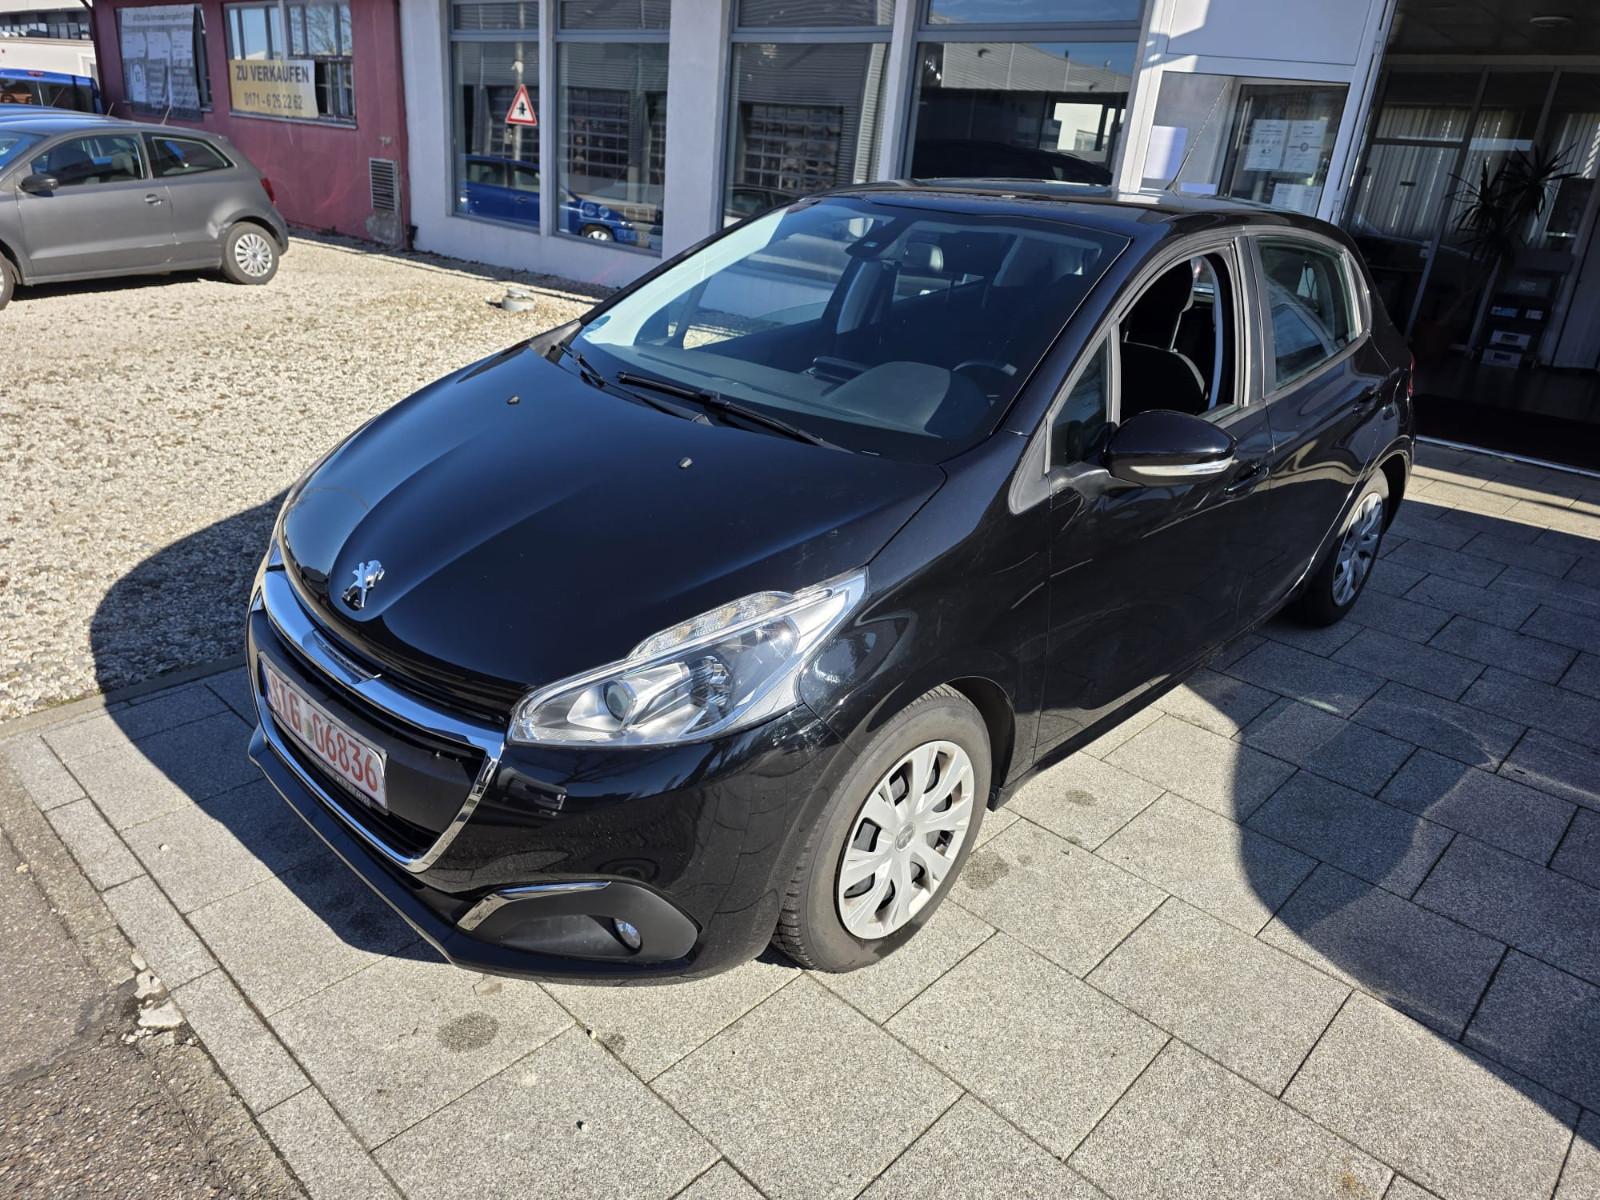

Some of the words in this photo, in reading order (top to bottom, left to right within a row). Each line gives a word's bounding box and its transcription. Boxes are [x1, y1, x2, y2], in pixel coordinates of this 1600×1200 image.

[236, 65, 248, 81] ZU
[250, 65, 310, 83] VERKAUFEN
[312, 713, 378, 792] 06836
